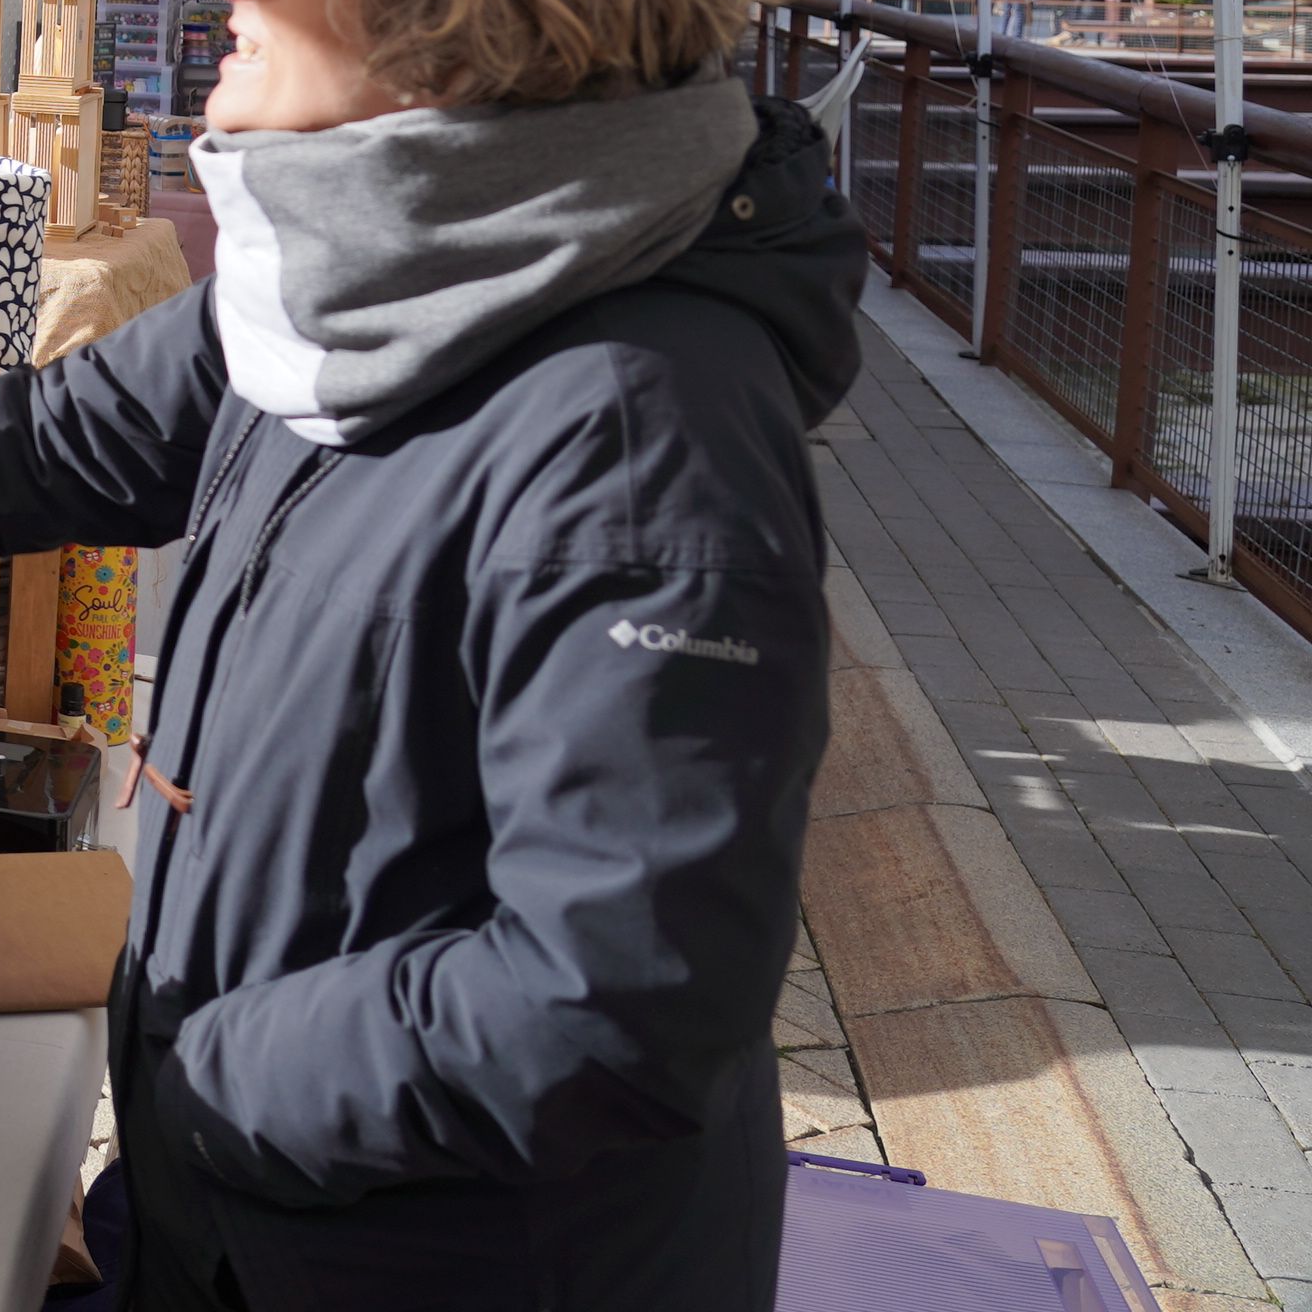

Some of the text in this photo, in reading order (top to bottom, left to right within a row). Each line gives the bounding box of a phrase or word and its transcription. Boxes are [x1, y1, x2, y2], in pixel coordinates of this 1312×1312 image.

[74, 584, 123, 621] Soul
[76, 622, 122, 639] SUNSHINE
[638, 624, 759, 665] Columbia
